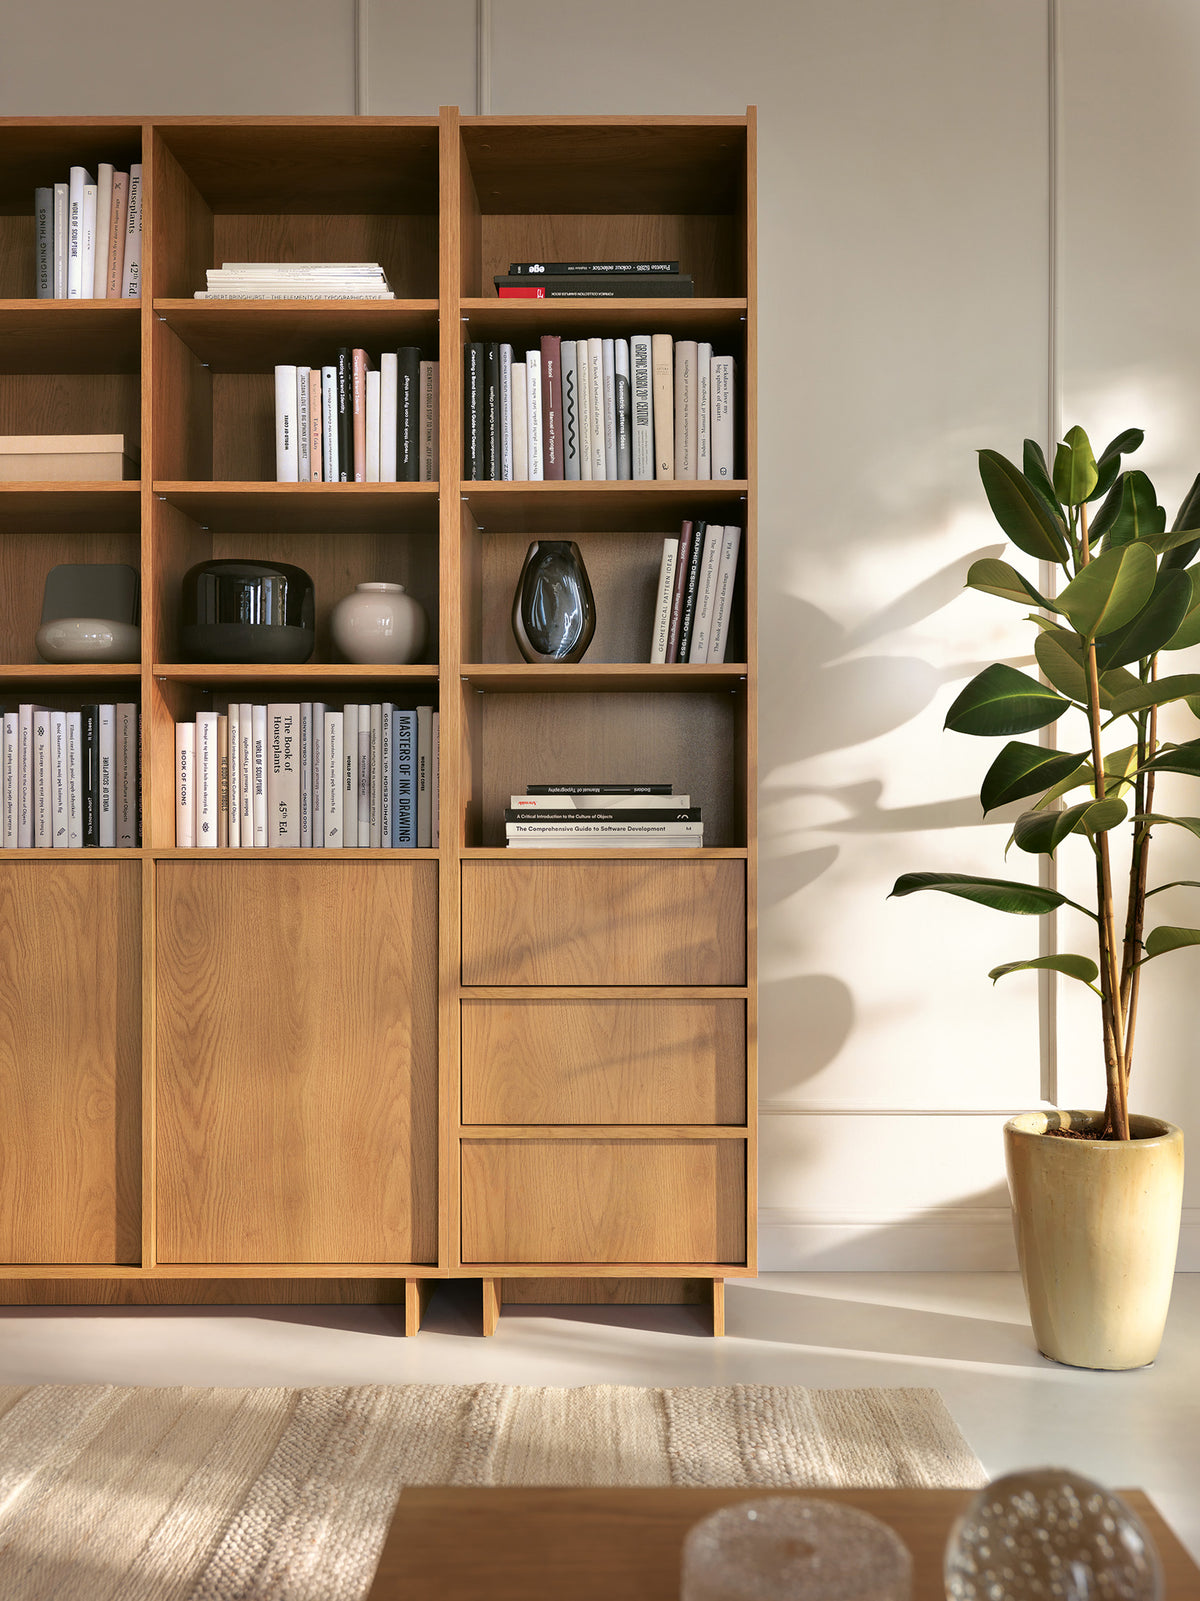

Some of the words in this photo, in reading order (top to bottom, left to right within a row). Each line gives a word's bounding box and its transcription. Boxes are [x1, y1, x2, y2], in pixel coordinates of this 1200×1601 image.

[128, 176, 140, 234] Houseplants
[528, 264, 545, 274] ege
[635, 344, 648, 369] GRAPHIC
[635, 369, 648, 388] DESIGN
[636, 401, 649, 427] CENTURY
[692, 531, 701, 564] GRAPHIC
[662, 575, 671, 604] PATTERN
[688, 565, 697, 593] DESIGN
[658, 606, 668, 652] GEOMETRICAL
[284, 716, 293, 735] The
[272, 716, 282, 774] Houseplants
[284, 736, 293, 759] Book
[399, 716, 411, 761] MASTERS
[181, 772, 186, 782] OF
[284, 762, 293, 772] of
[399, 764, 411, 776] OF
[399, 779, 410, 795] INK
[278, 822, 288, 836] Ed.
[399, 799, 411, 843] DRAWING
